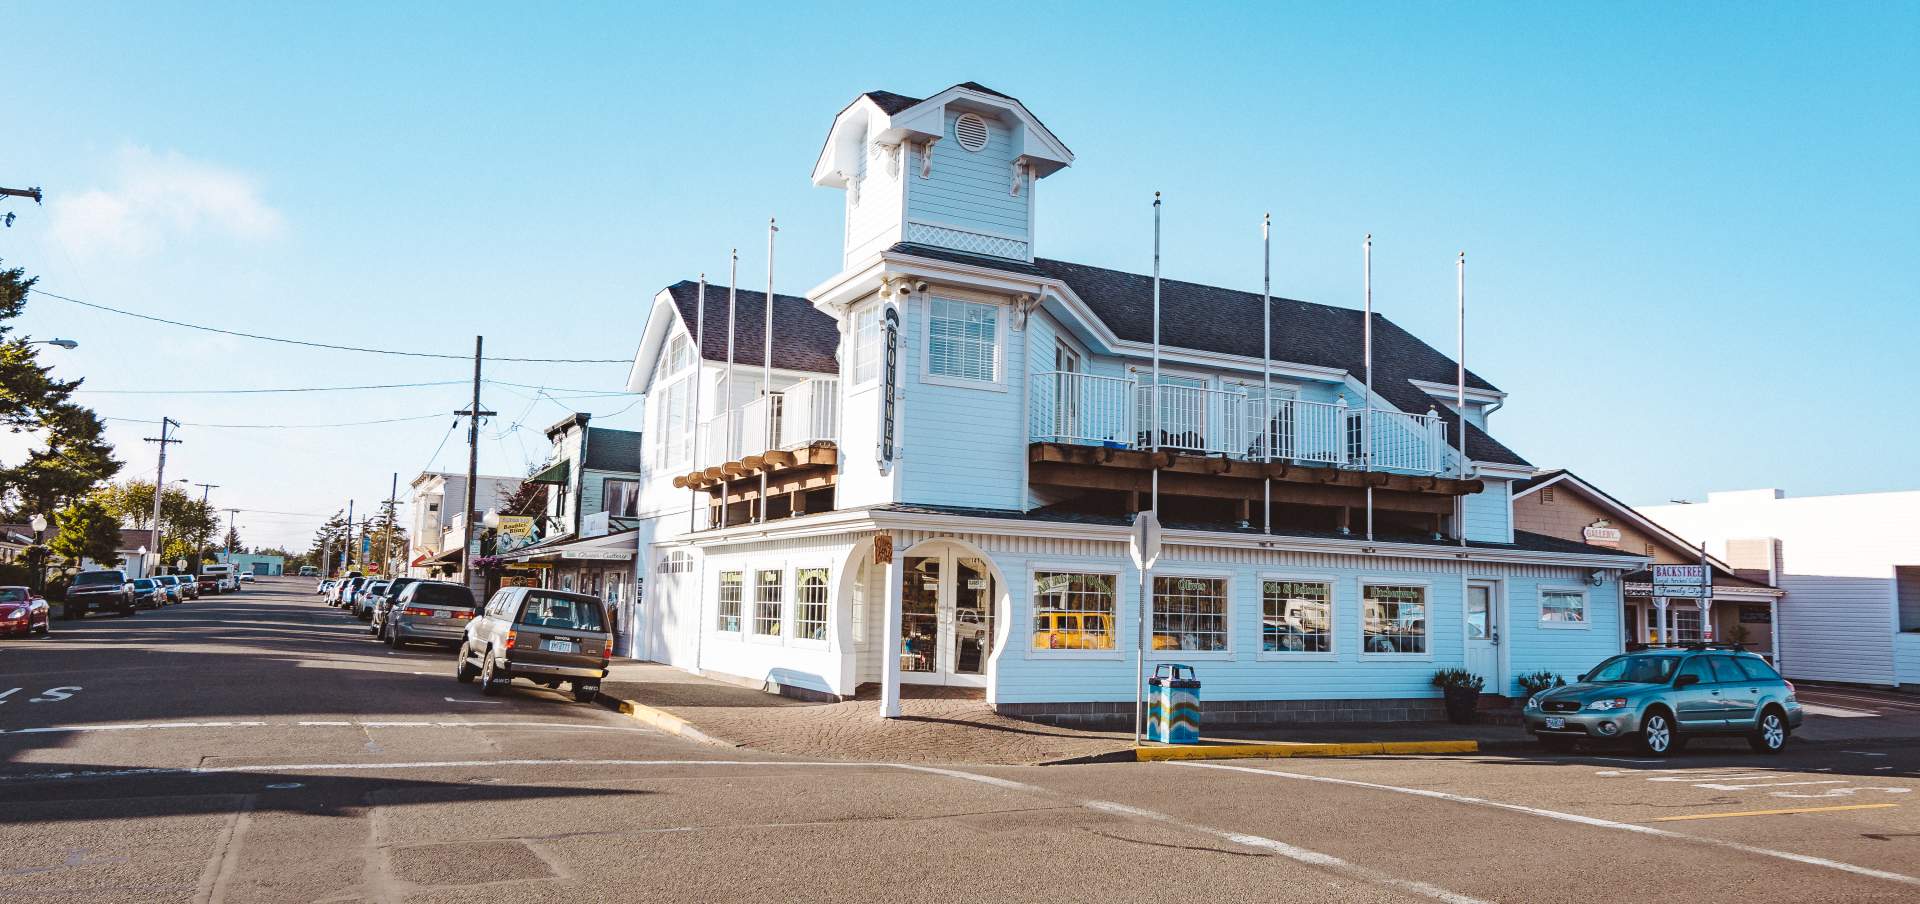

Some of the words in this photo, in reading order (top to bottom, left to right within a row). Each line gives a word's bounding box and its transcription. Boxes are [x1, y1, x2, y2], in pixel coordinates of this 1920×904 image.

[885, 331, 897, 457] GOURMET
[1656, 566, 1703, 577] BACKSTREE
[1178, 579, 1206, 591] Olives
[1263, 582, 1281, 594] Oils
[1283, 583, 1291, 594] &
[1658, 586, 1686, 595] Family
